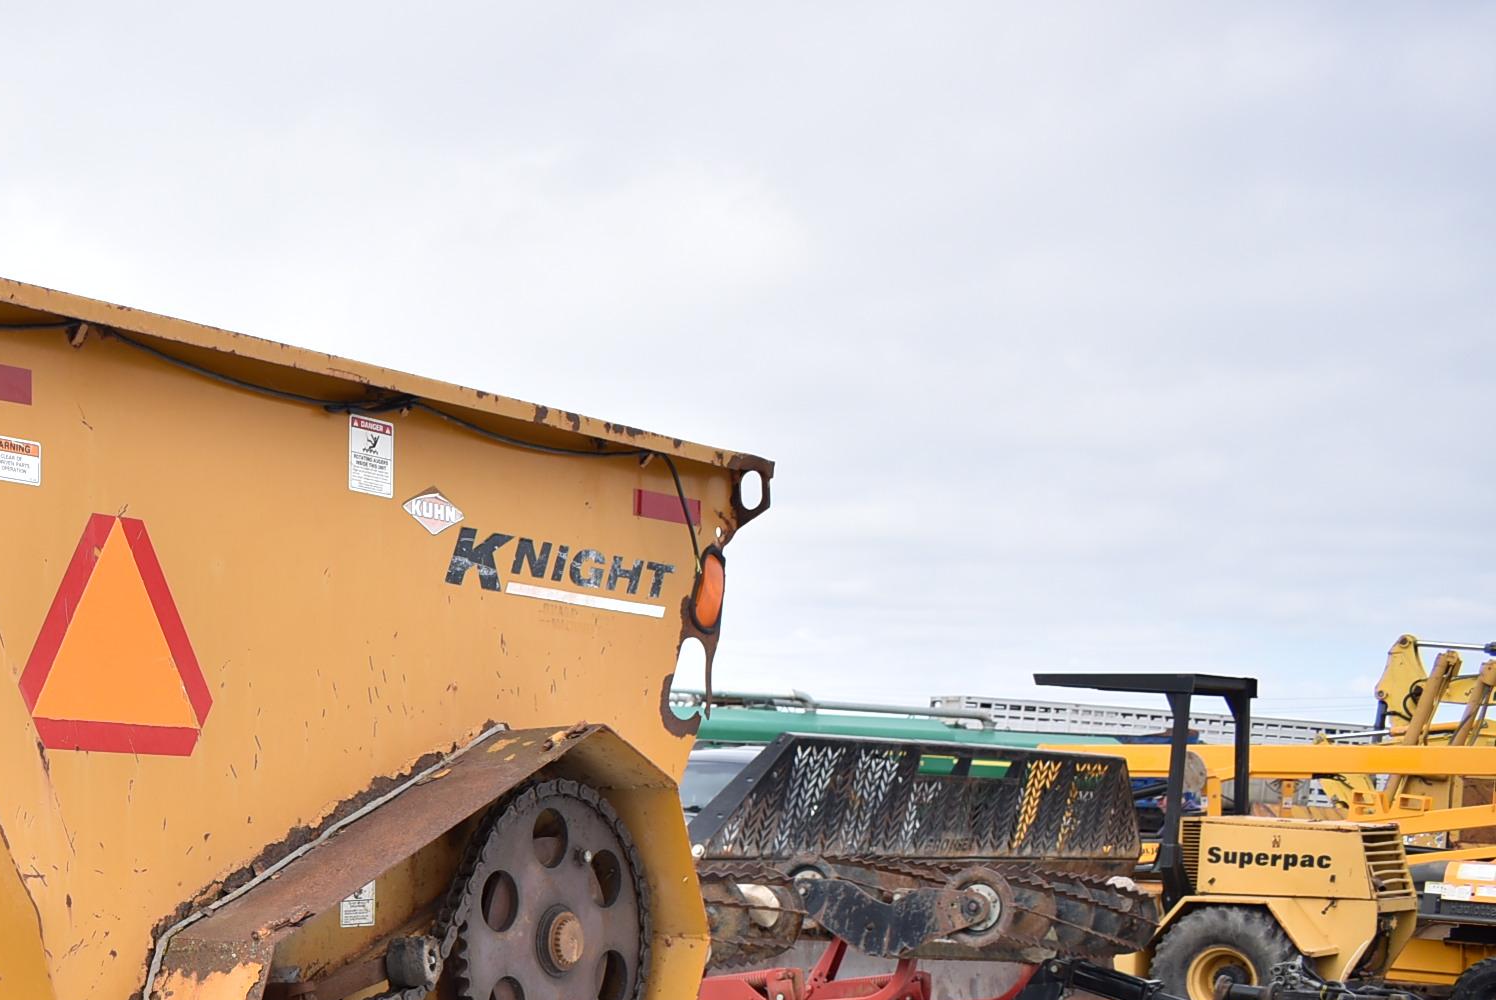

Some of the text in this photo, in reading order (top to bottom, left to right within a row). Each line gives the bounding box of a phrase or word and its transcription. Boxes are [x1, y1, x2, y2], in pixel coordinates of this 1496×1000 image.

[360, 420, 384, 432] DANGER
[411, 499, 456, 523] KUHN
[1207, 846, 1332, 871] Superpac
